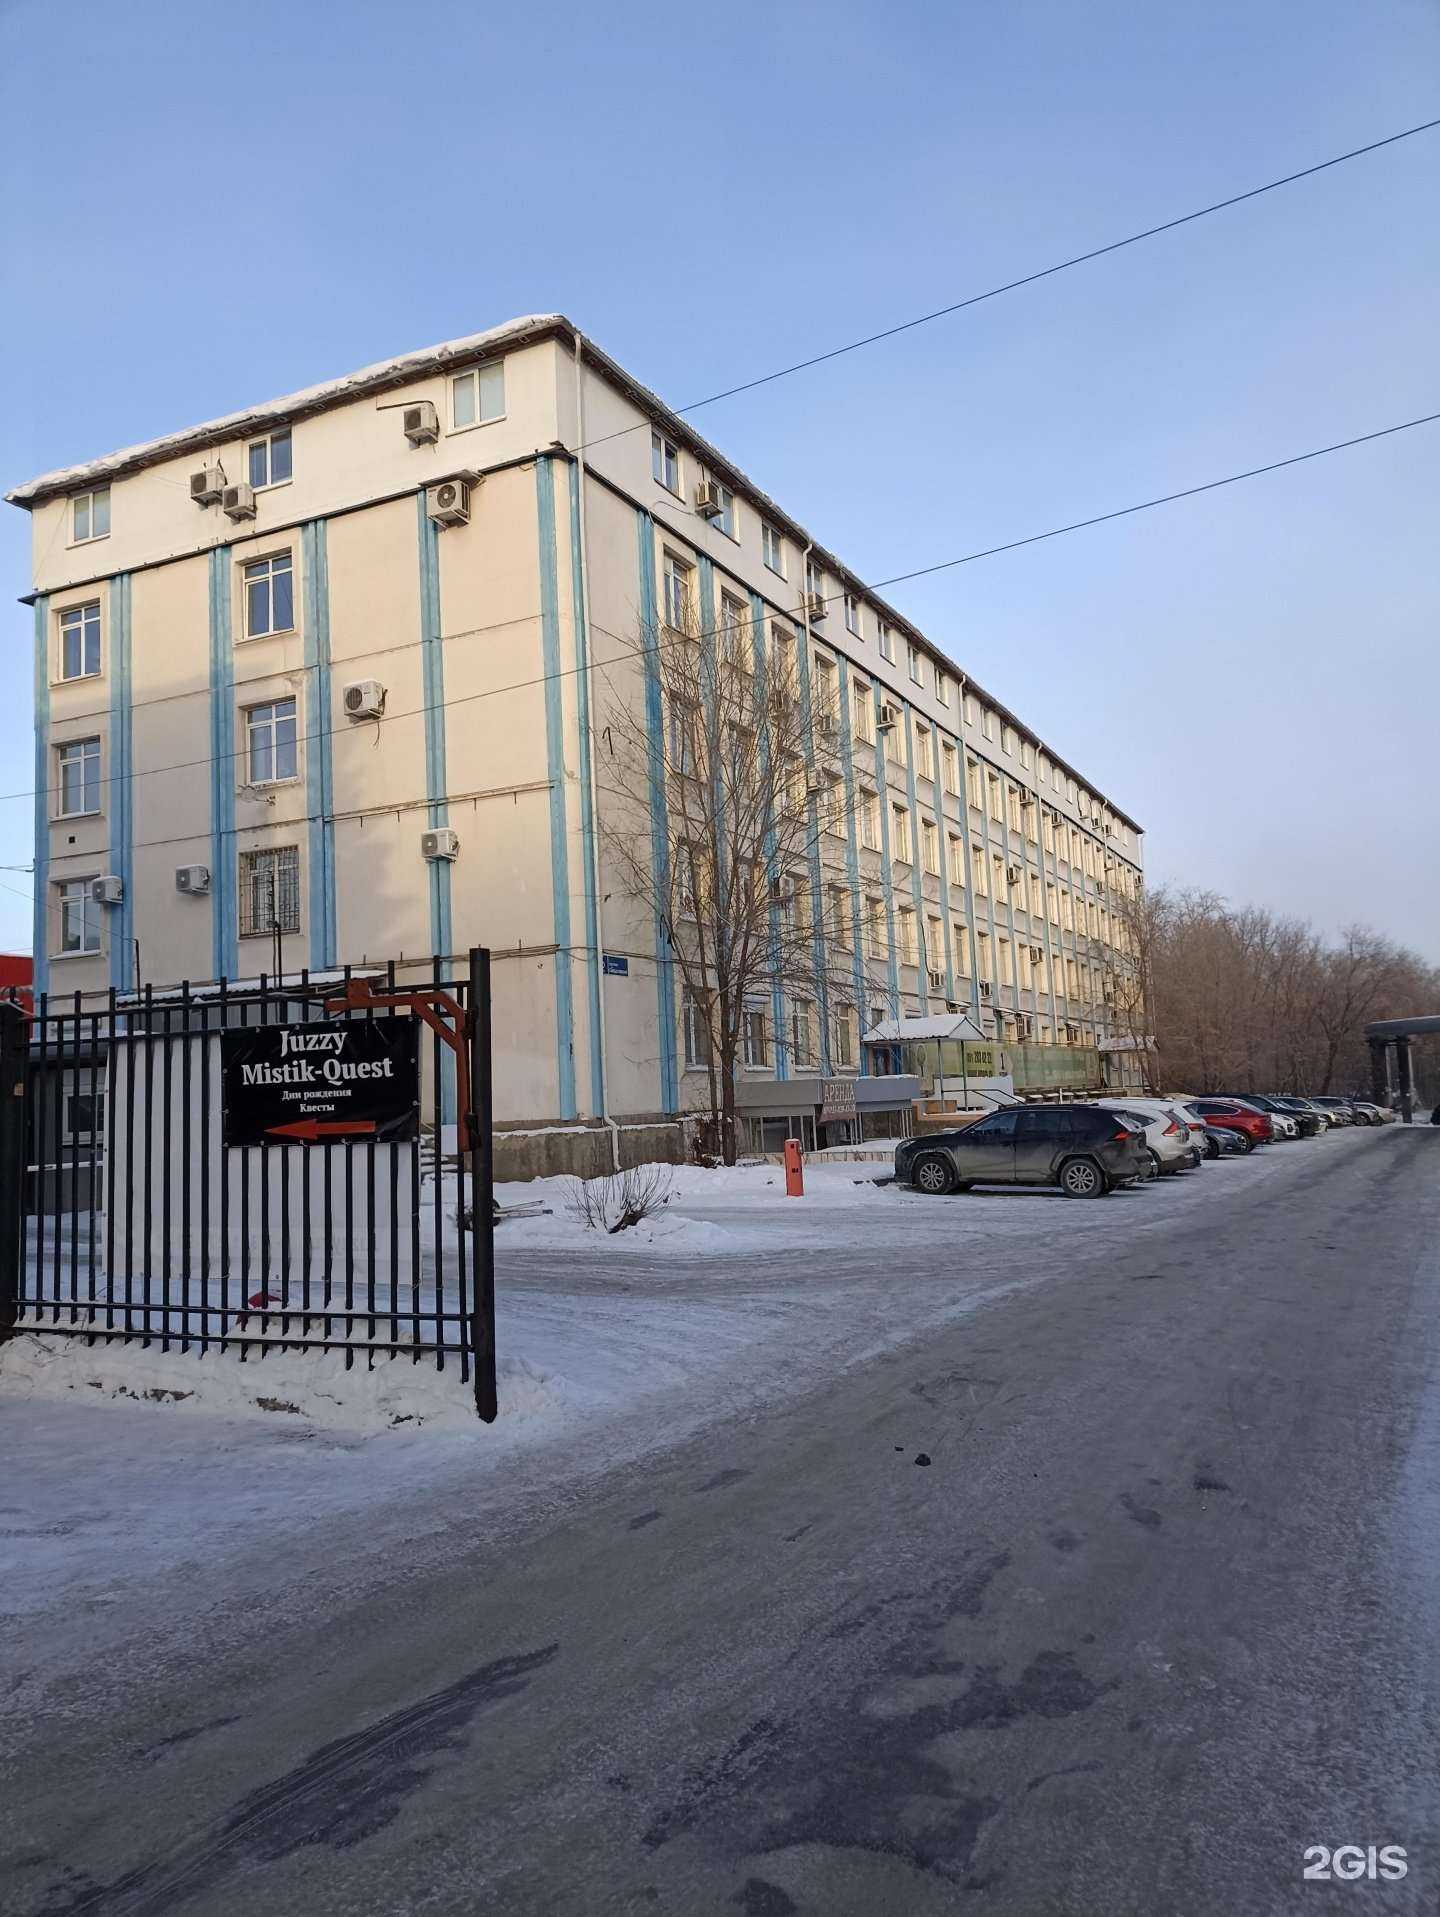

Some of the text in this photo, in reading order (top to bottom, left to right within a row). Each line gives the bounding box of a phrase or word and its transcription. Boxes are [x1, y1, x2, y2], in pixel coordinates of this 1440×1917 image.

[280, 1030, 348, 1057] Juzzy
[241, 1057, 394, 1086] Mistik-Quest
[282, 1088, 352, 1101] Дни рождения
[824, 1083, 855, 1103] АРЕНДА
[299, 1103, 335, 1113] Квесты
